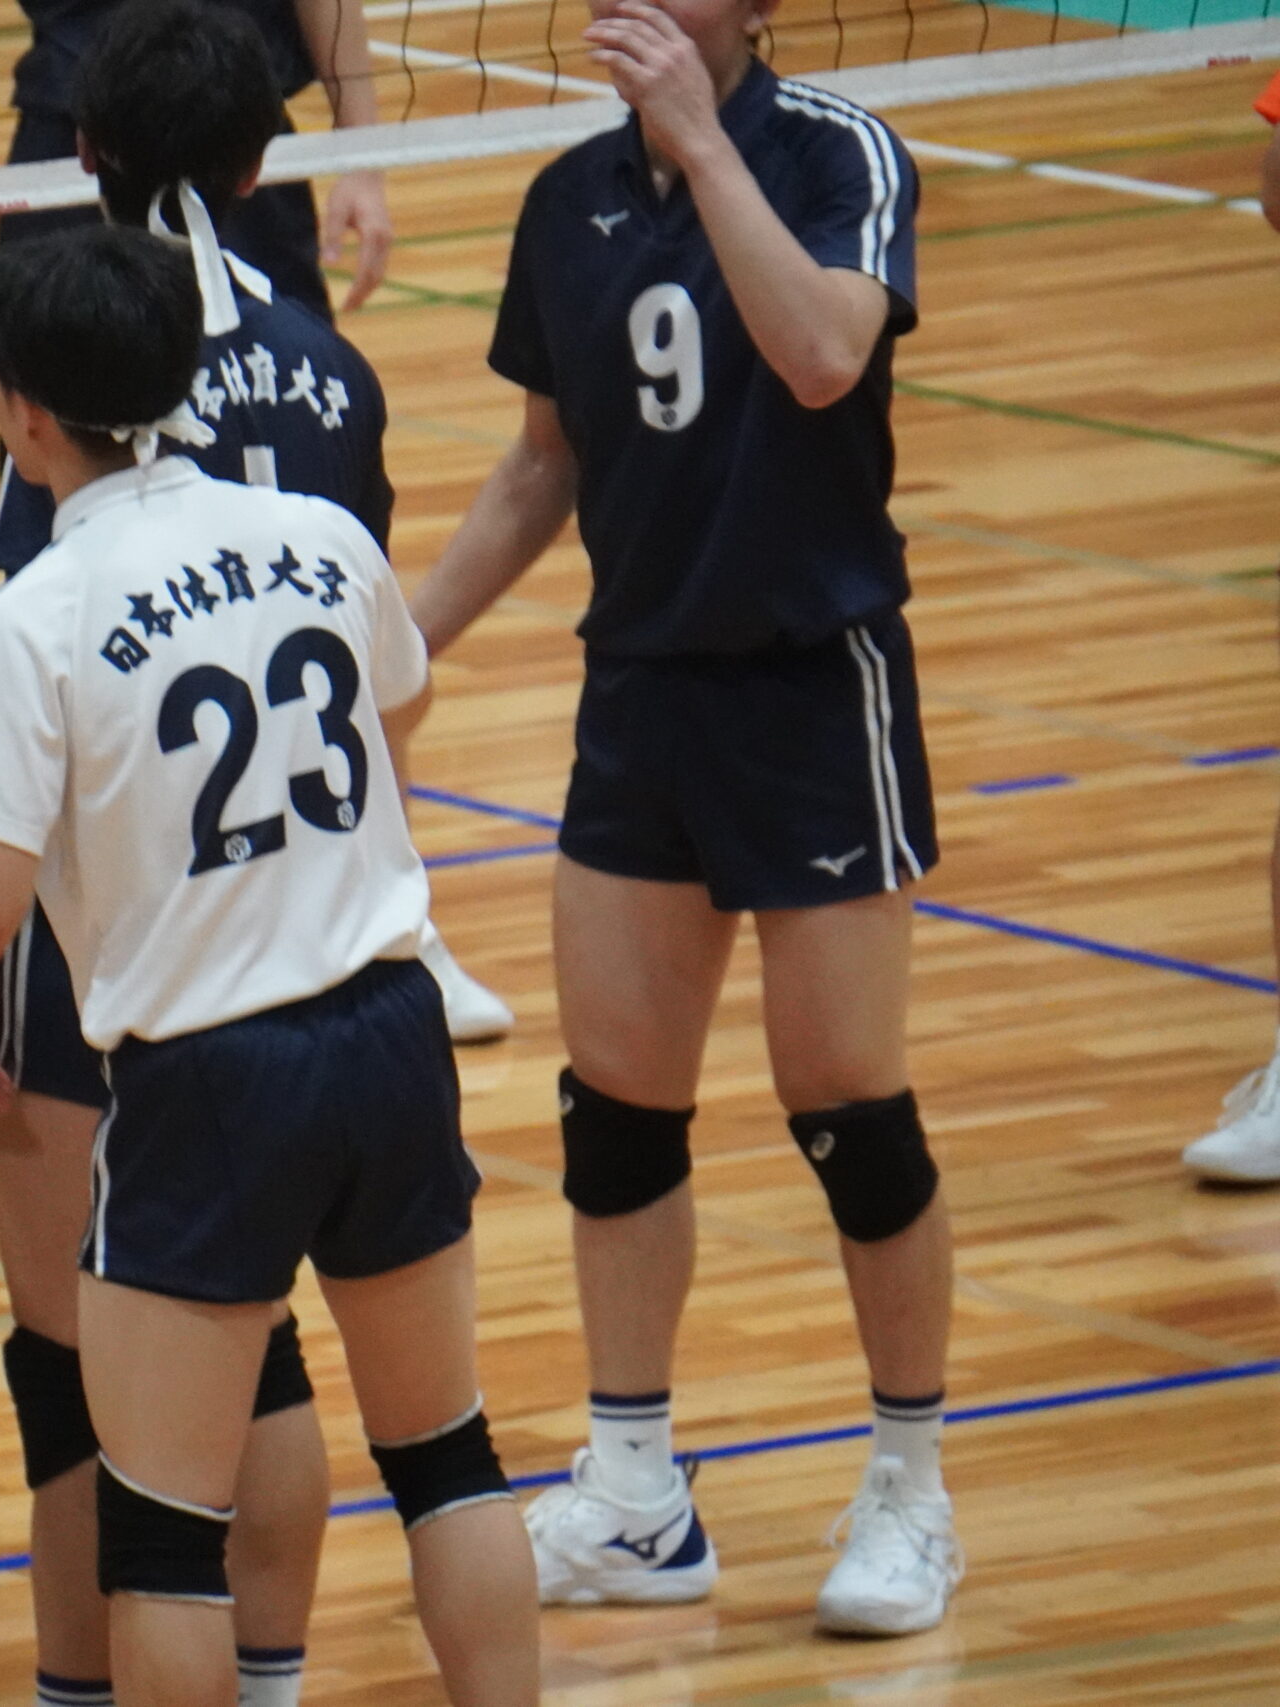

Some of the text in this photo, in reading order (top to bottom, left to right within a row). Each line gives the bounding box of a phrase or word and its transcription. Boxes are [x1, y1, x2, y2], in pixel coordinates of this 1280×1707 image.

[192, 342, 350, 430] 本体育大学
[628, 282, 704, 432] 9
[100, 543, 348, 673] 日本体育大学
[157, 626, 368, 877] 23
